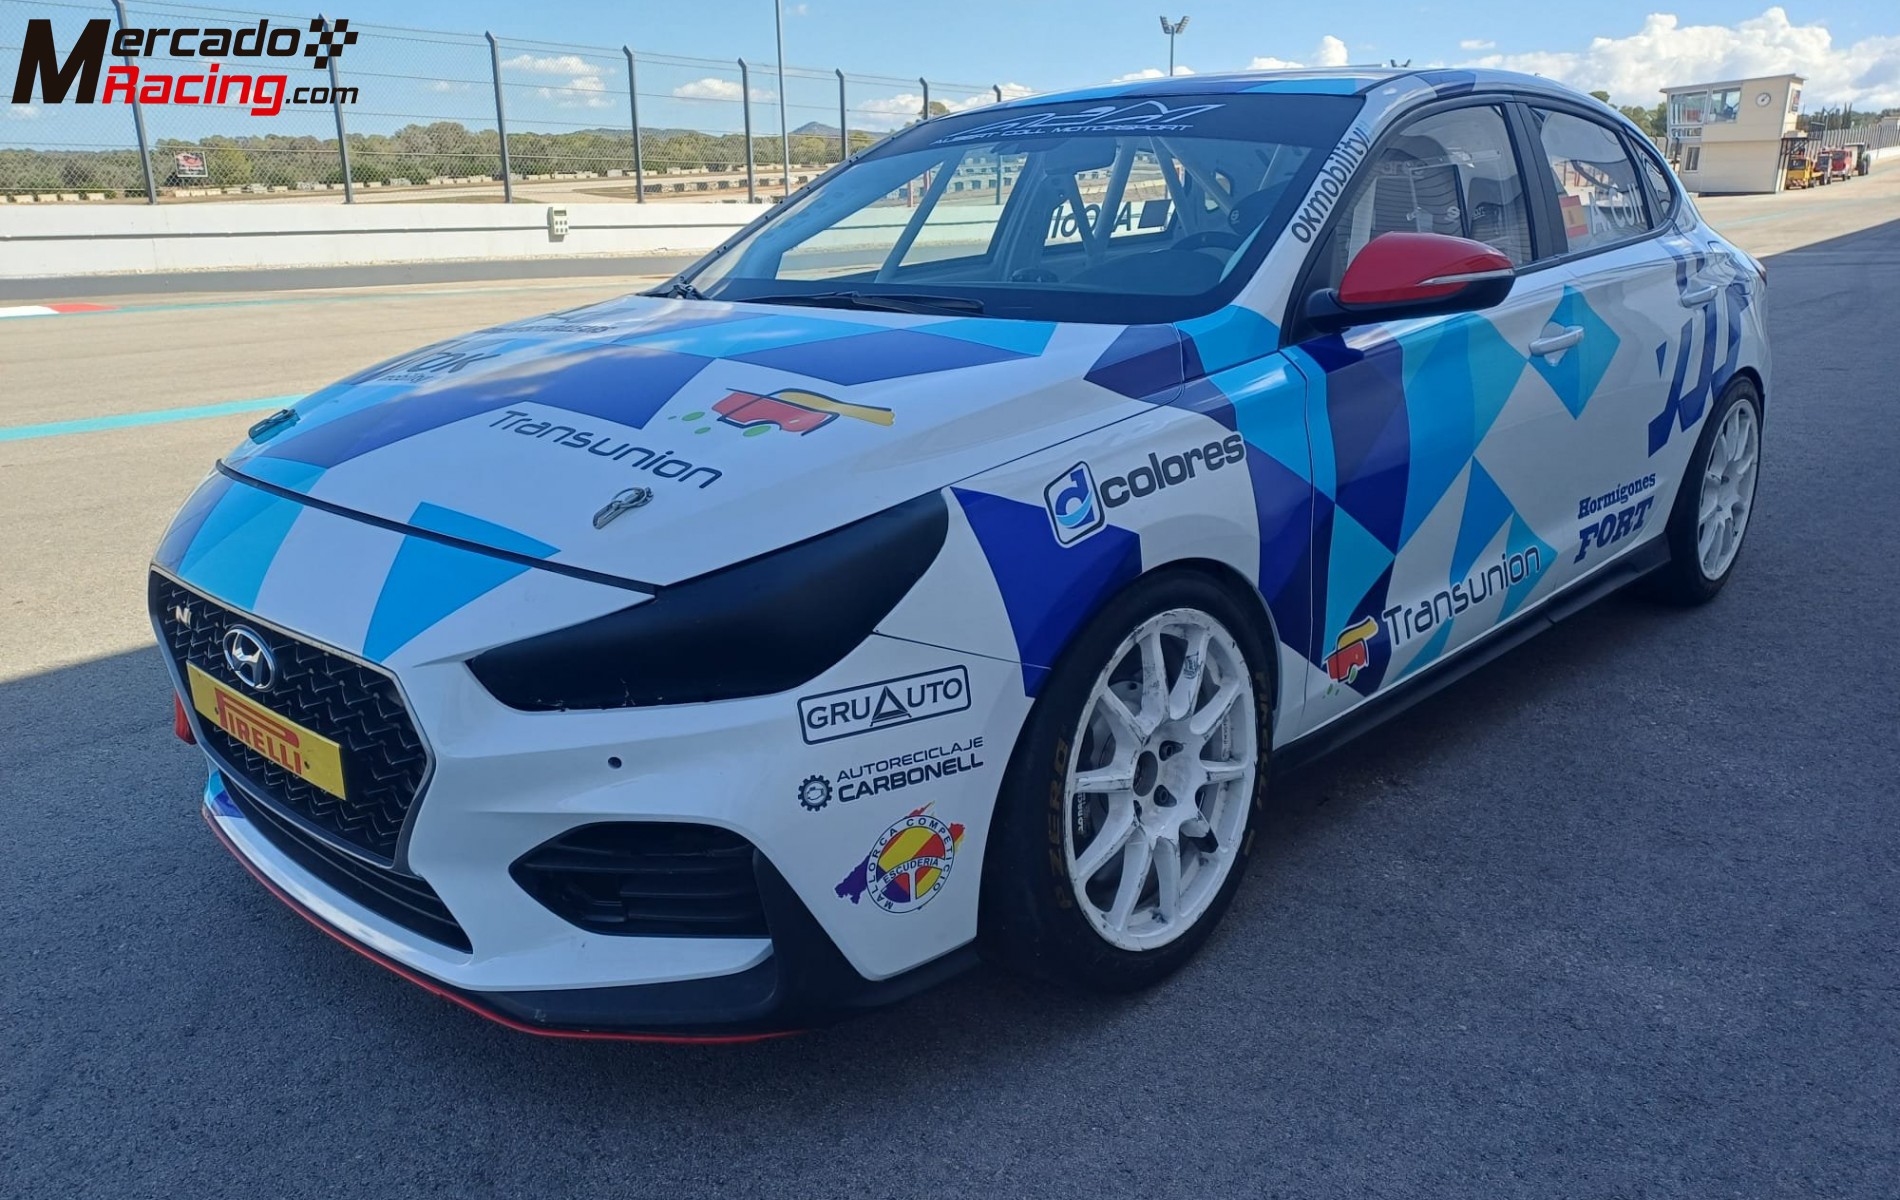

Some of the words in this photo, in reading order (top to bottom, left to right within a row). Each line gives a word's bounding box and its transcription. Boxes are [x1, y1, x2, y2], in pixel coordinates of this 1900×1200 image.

[1051, 124, 1194, 133] MOTORSPORT
[489, 410, 723, 489] Transunion
[1100, 434, 1245, 508] colores
[1573, 495, 1654, 564] FORT
[1578, 472, 1656, 519] Hormigones
[1383, 546, 1540, 645] Transunion
[215, 687, 302, 775] PIRELLI
[837, 736, 984, 783] AUTORECICLAJE
[838, 753, 984, 803] CARBONELL
[1047, 736, 1069, 877] ZERO
[868, 828, 898, 910] MALLORCA
[882, 857, 939, 885] ESCUDERIA
